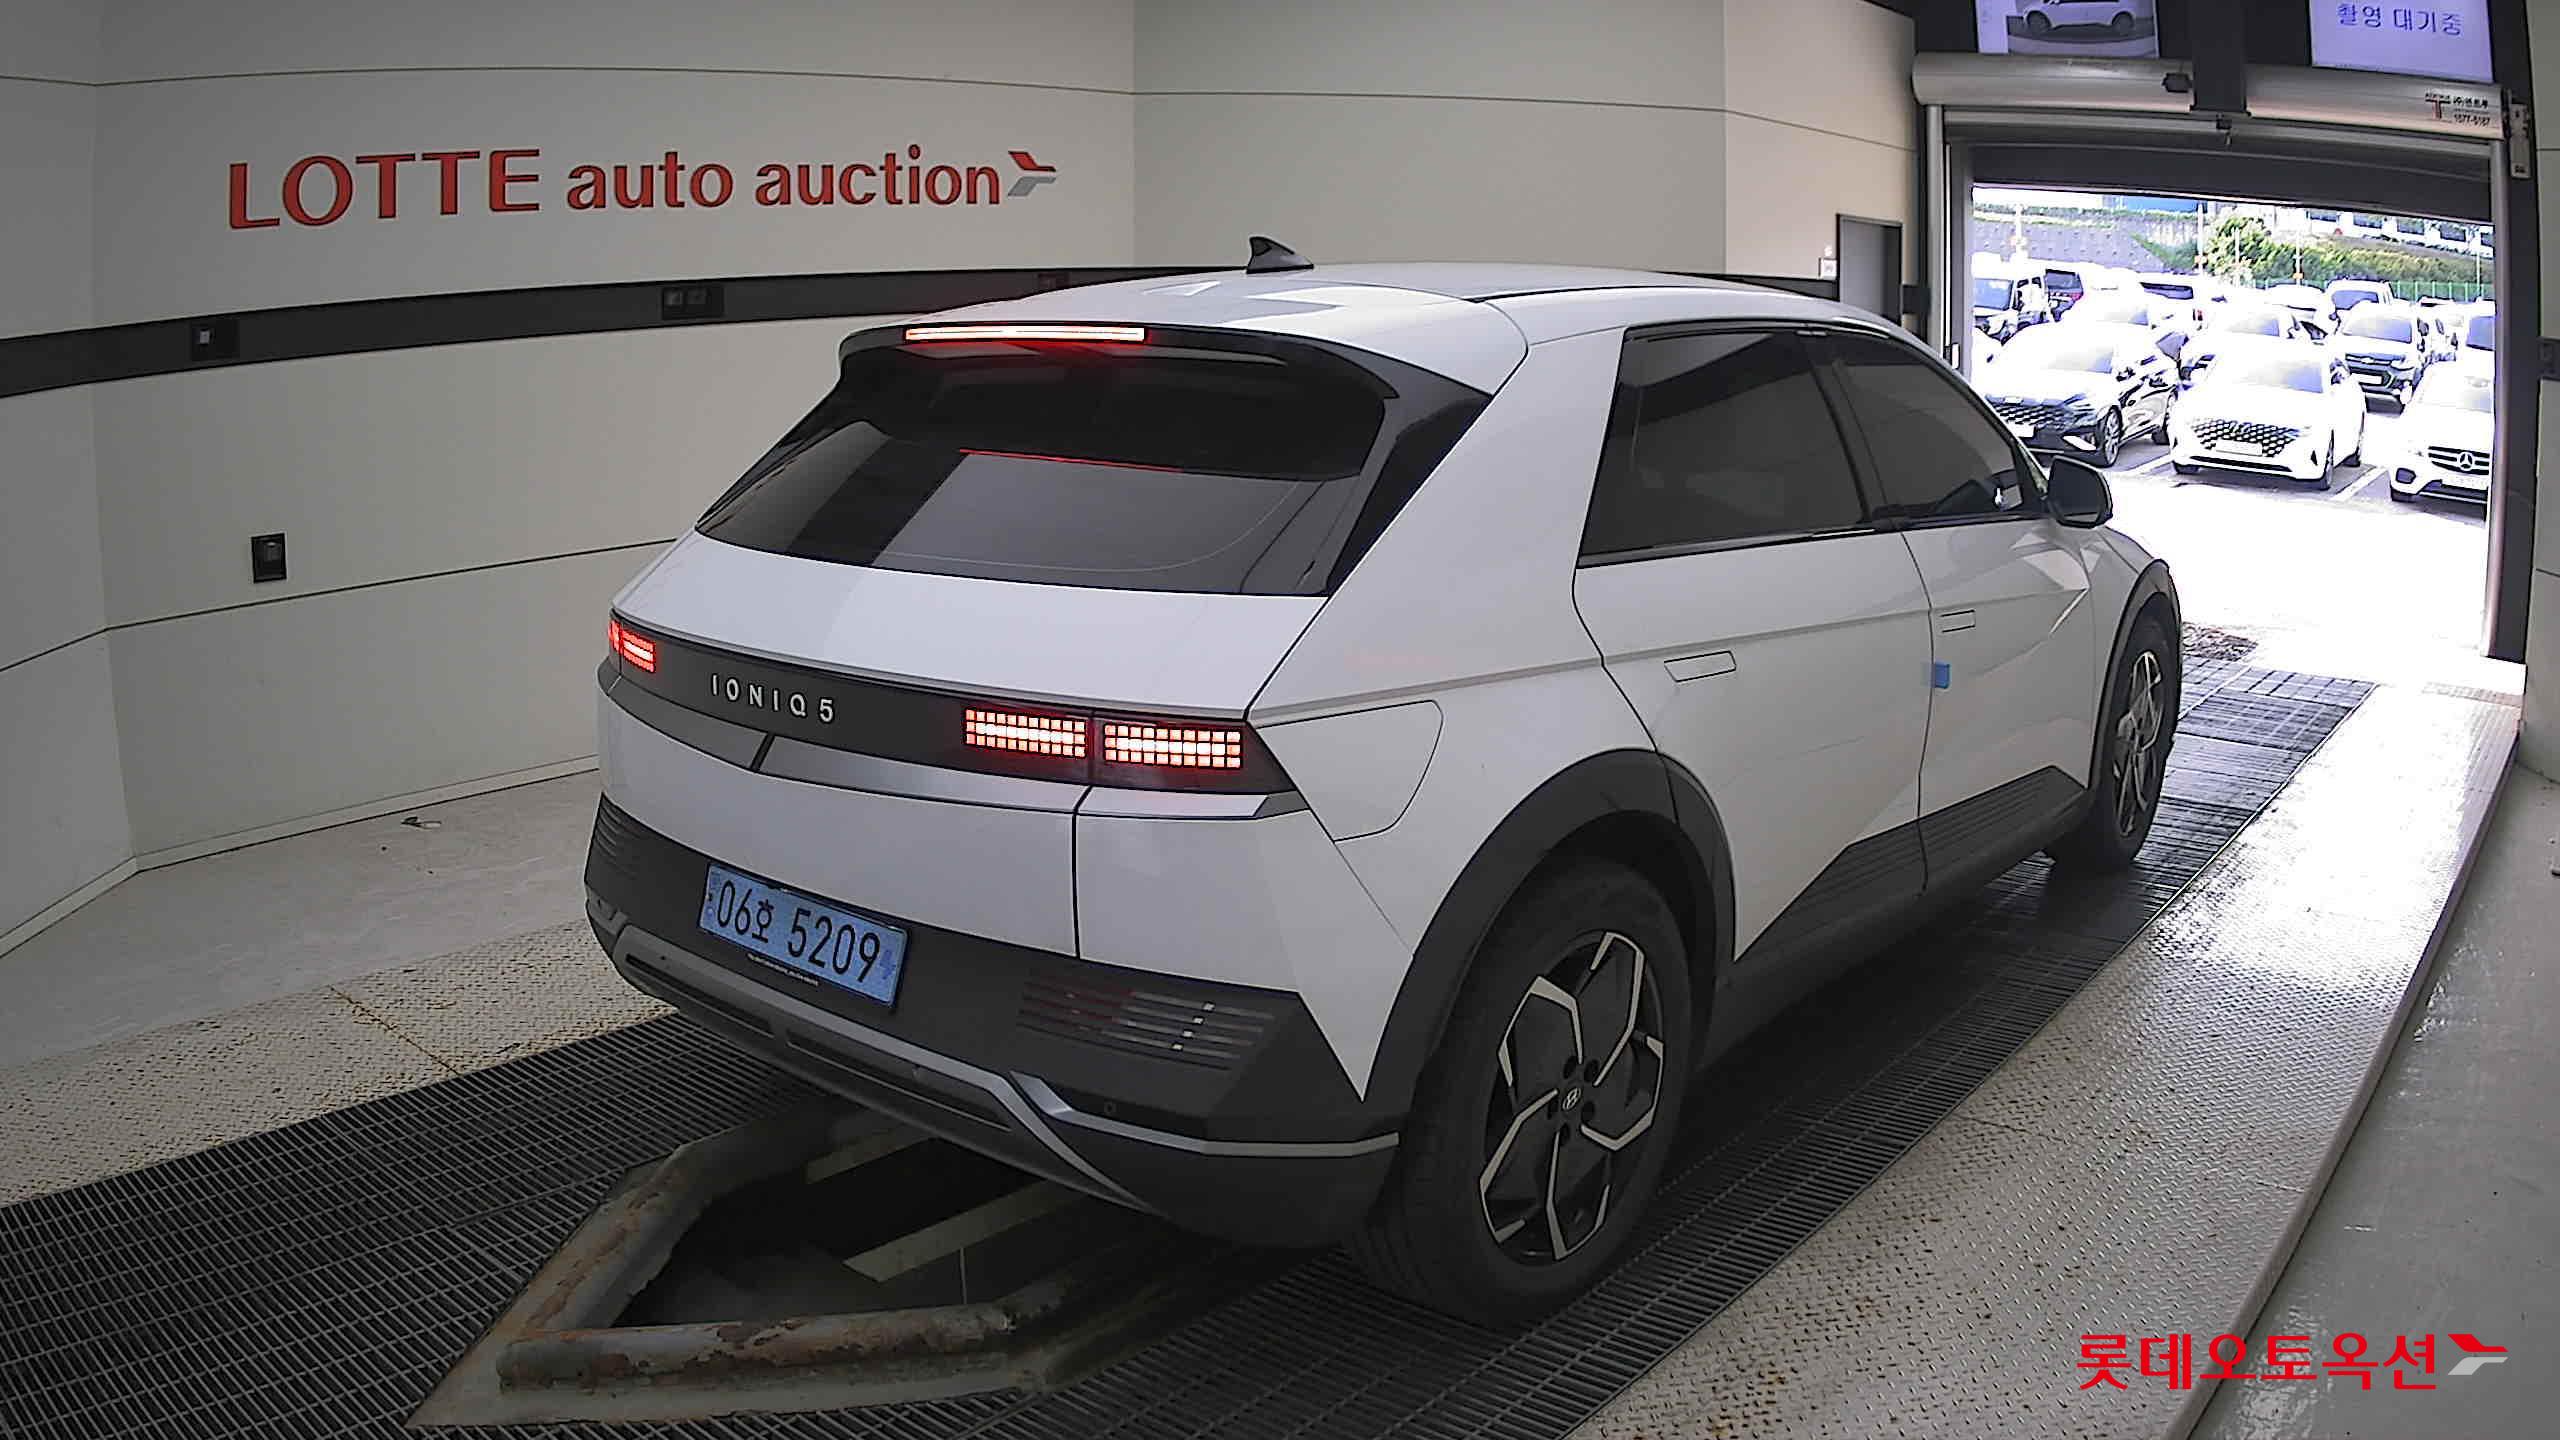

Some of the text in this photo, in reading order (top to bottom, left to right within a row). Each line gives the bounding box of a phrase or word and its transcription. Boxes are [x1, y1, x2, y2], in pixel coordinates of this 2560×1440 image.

[2393, 9, 2461, 36] 대기중
[229, 144, 1000, 229] LOTTE auto auction
[712, 674, 834, 722] IONIQ 5
[717, 880, 774, 944] 06호
[787, 907, 880, 983] 5209
